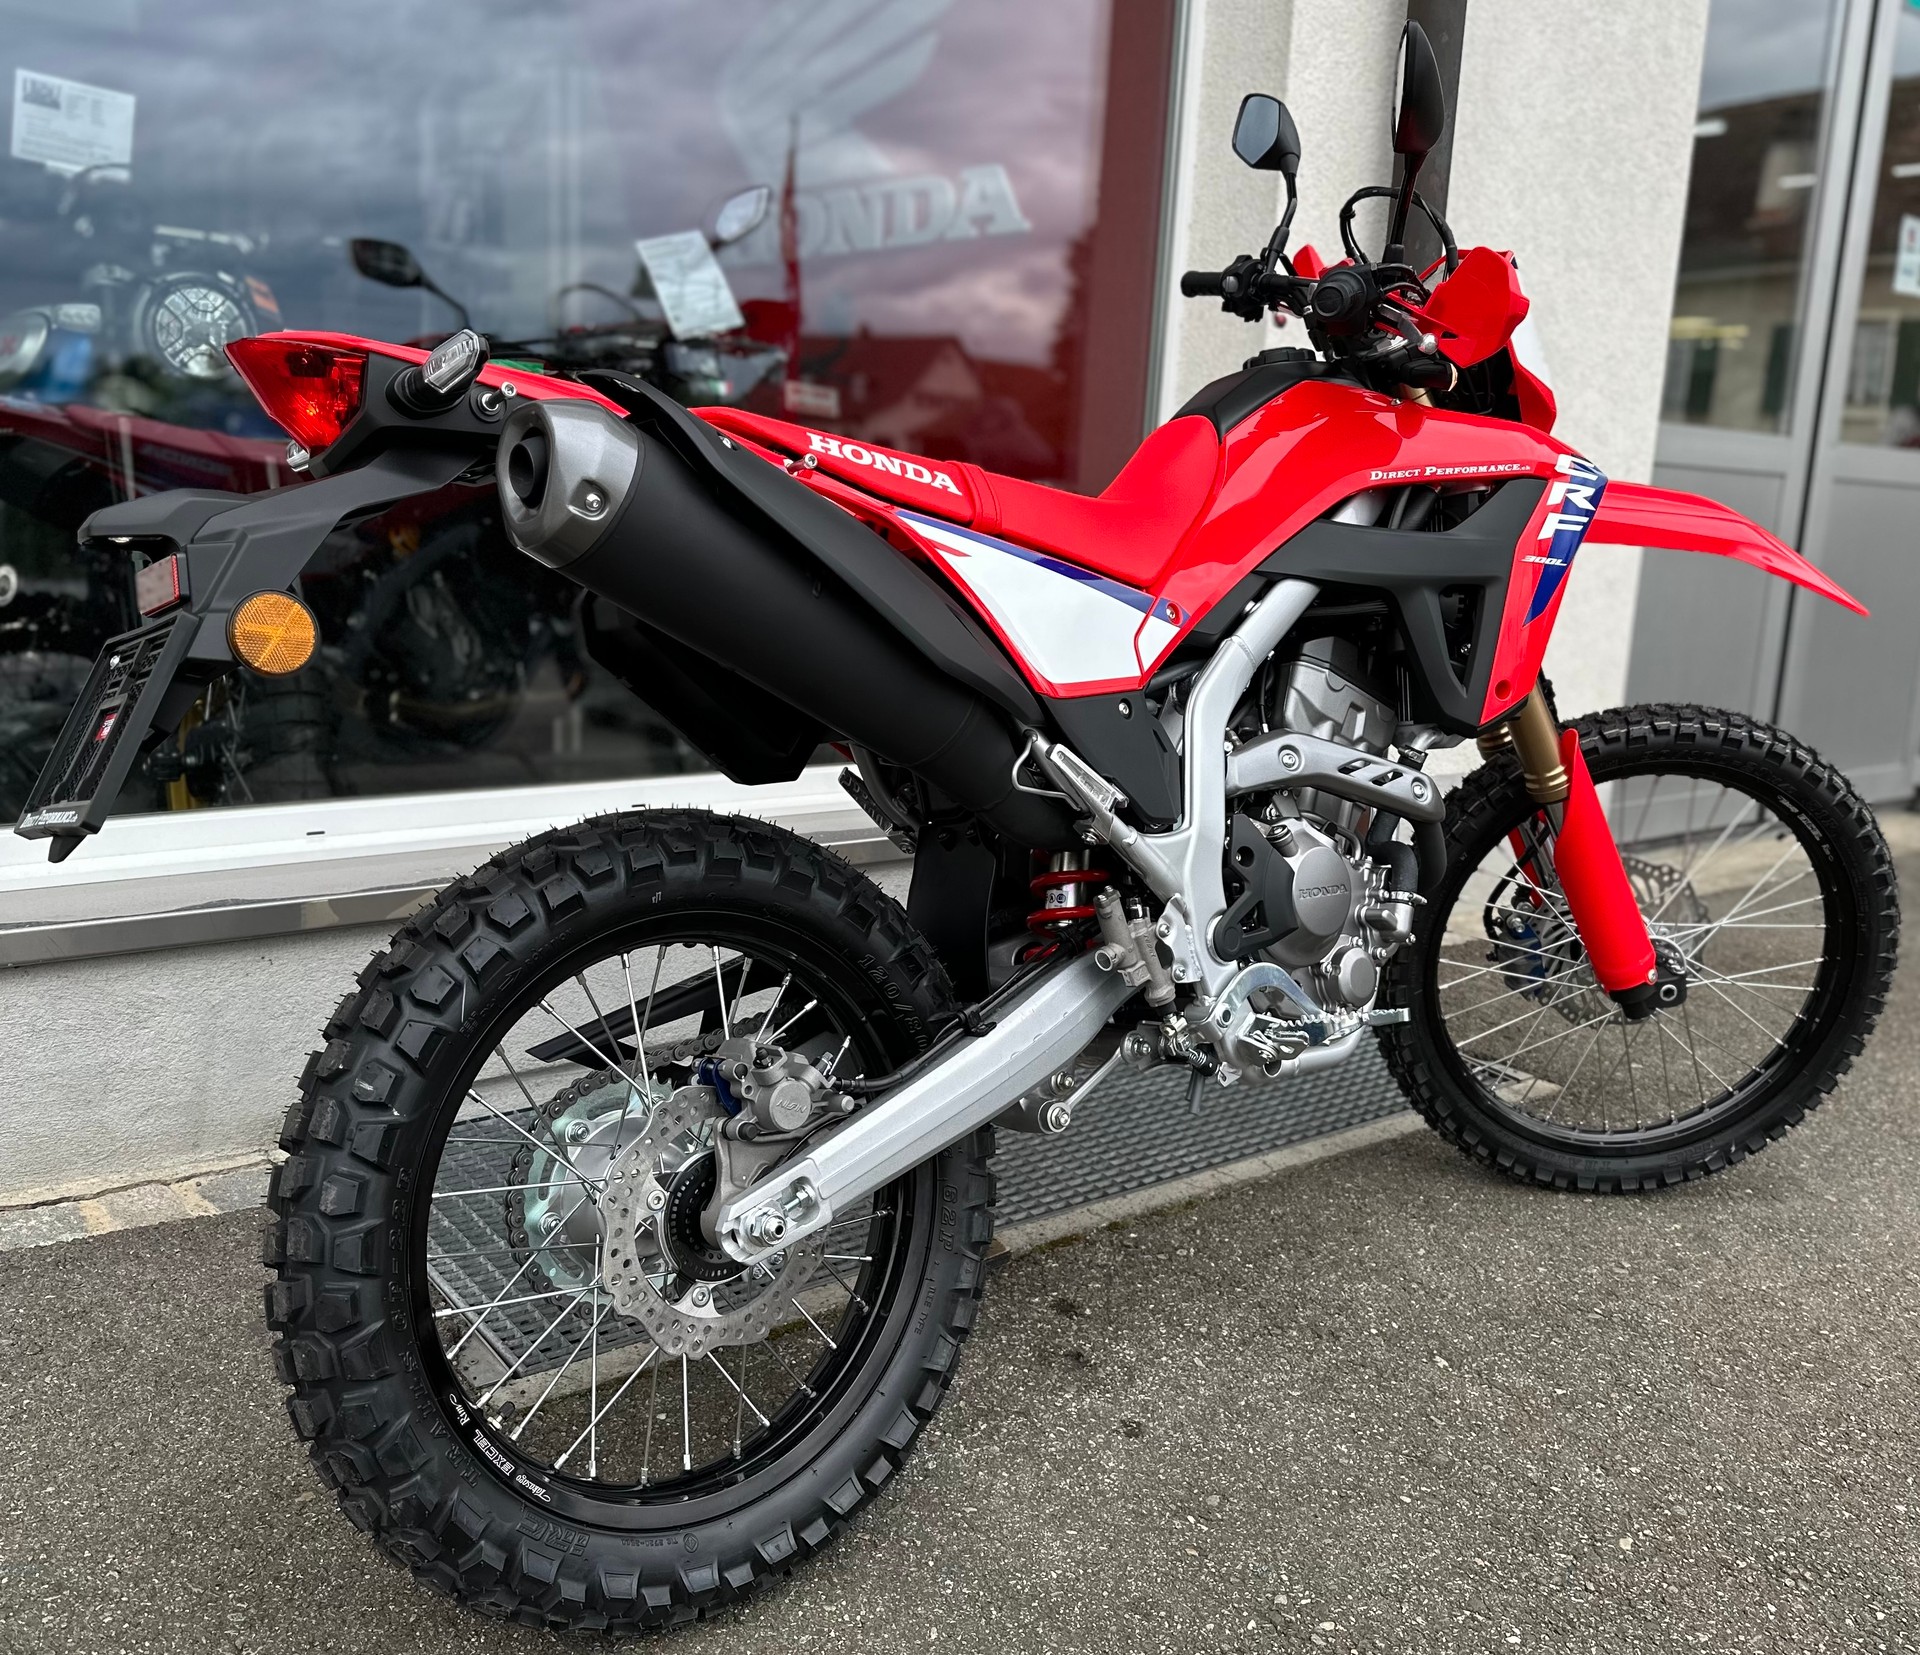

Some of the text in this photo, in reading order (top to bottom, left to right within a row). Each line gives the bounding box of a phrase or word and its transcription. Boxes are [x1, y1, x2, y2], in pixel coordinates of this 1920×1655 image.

[806, 432, 963, 496] HONDA
[1537, 454, 1598, 540] CRF
[1521, 555, 1568, 566] 300L
[1299, 884, 1348, 900] HONDA
[473, 1429, 515, 1476] EXCEL
